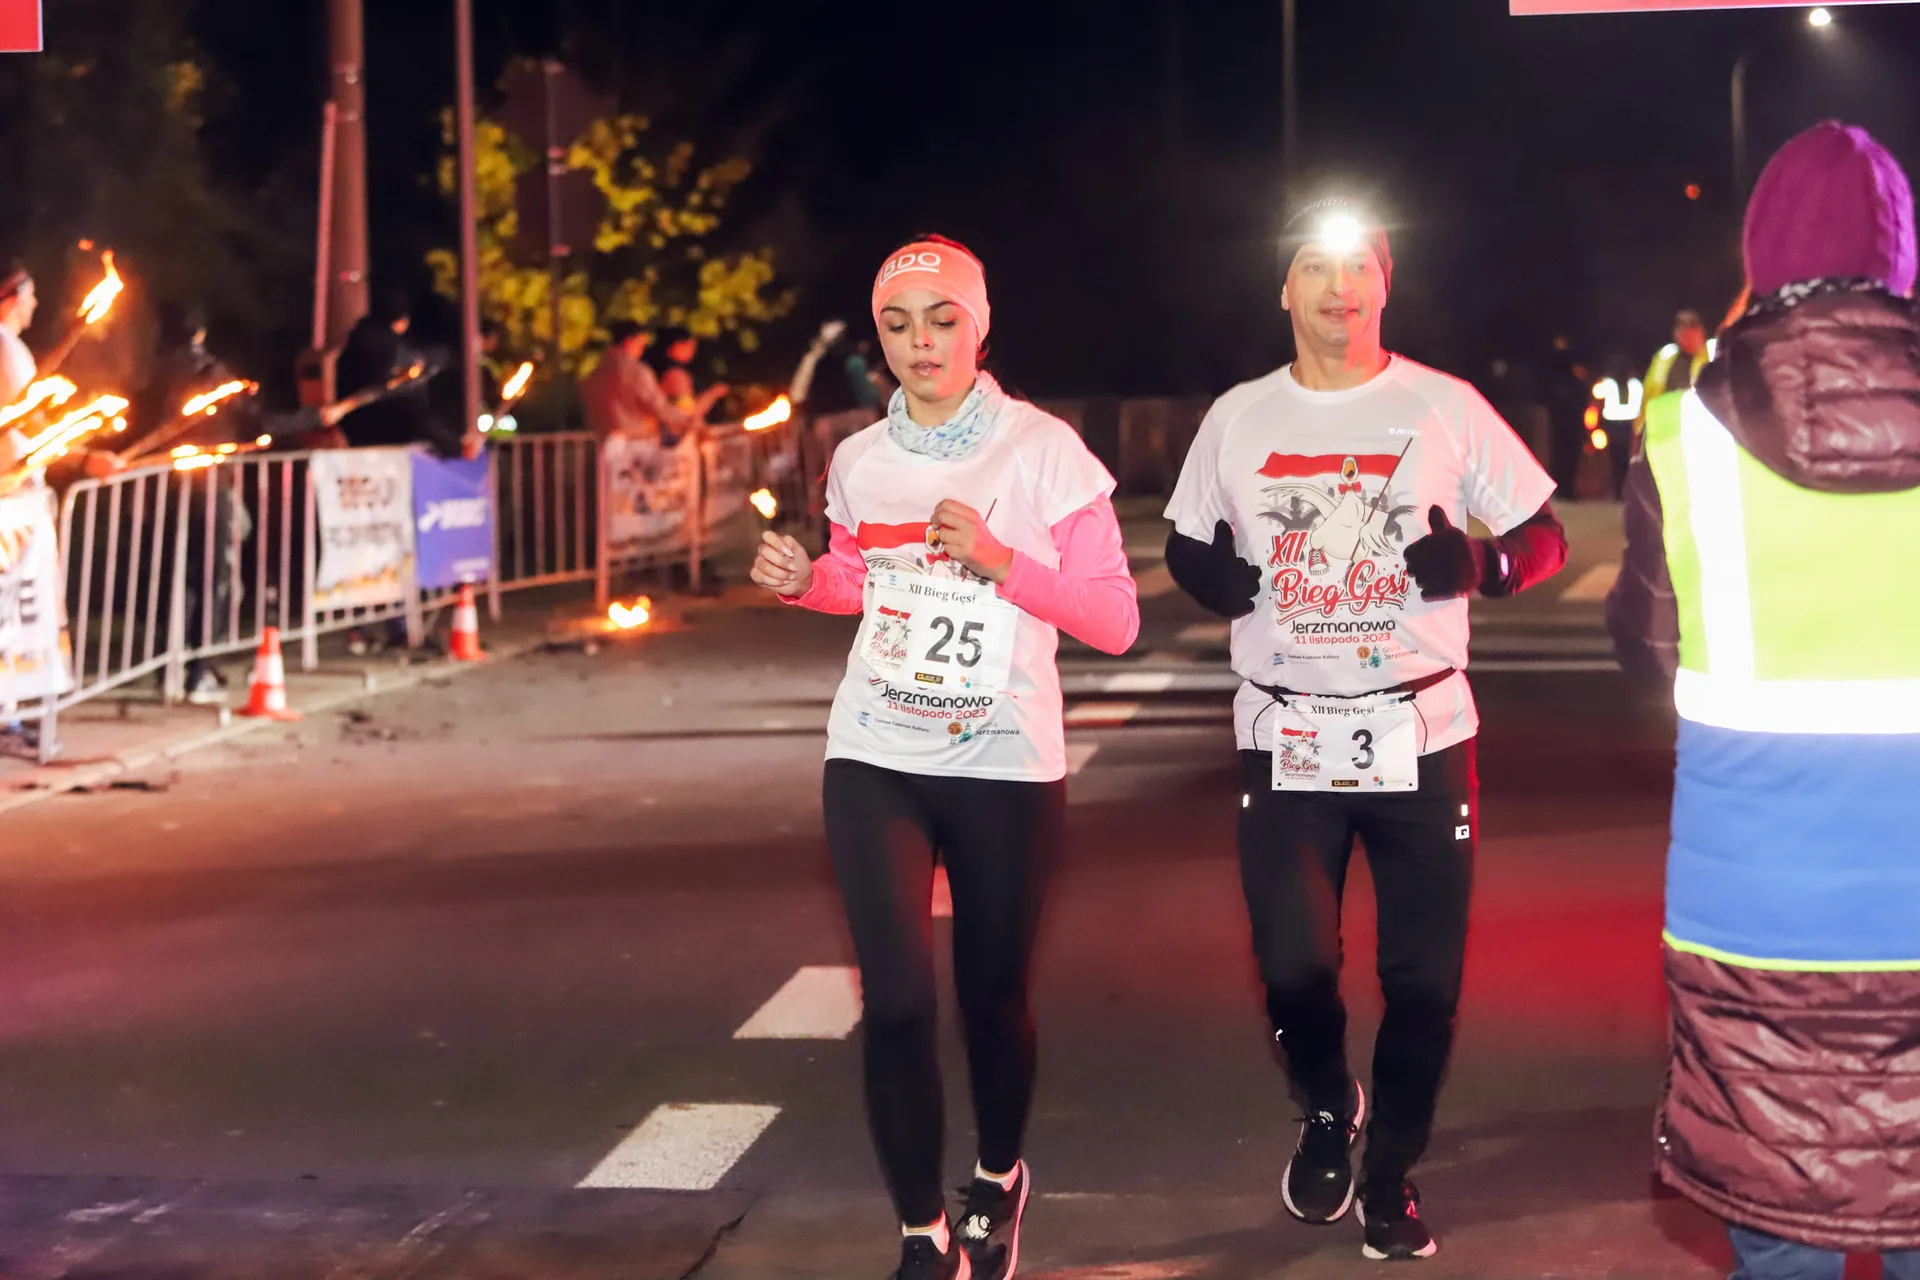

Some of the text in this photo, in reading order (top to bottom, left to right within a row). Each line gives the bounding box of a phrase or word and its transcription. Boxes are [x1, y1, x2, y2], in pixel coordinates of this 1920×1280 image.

[1269, 531, 1308, 565] XII
[908, 583, 922, 595] XII
[924, 586, 949, 601] Bieg
[951, 591, 977, 604] Gęsi
[1273, 559, 1410, 614] Bieg Gęsi
[1290, 619, 1396, 634] Jerzmanowa
[924, 615, 985, 668] 25
[1294, 632, 1391, 646] 11 listopada 2023
[881, 683, 993, 709] Jerzmanowa
[887, 700, 987, 720] 11 listopada 2023
[1310, 704, 1325, 714] XII
[1327, 706, 1350, 717] Bieg
[1352, 705, 1375, 717] Gęsi
[1351, 728, 1375, 770] 3
